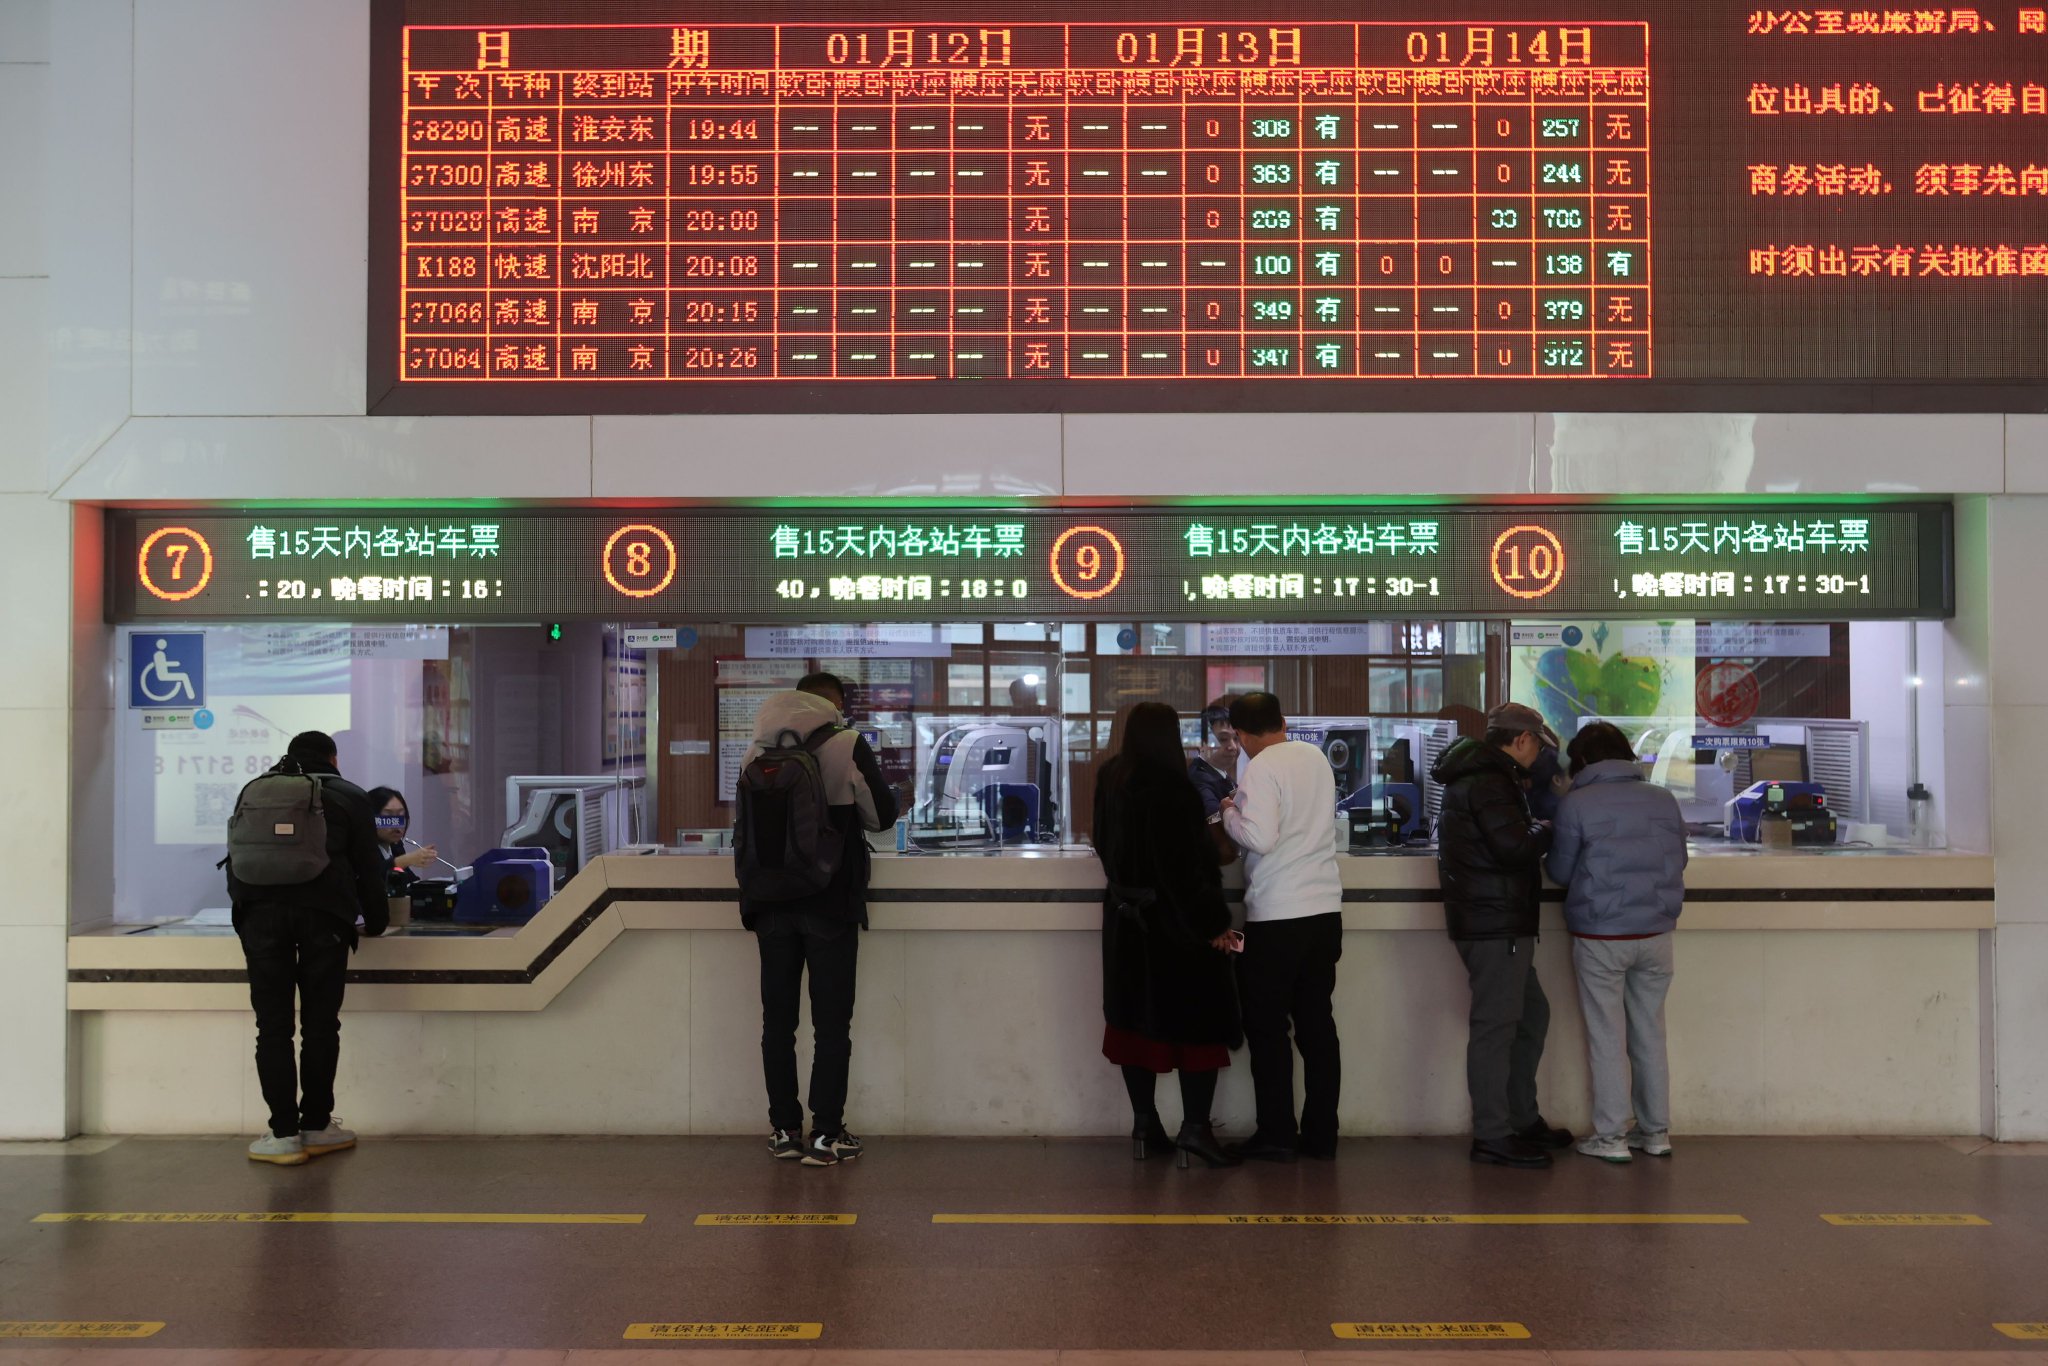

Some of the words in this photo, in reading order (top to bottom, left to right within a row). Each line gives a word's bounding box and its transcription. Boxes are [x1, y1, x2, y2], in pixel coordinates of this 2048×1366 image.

[477, 28, 511, 69] 日
[667, 27, 710, 69] 期
[826, 28, 1012, 69] 01月12日
[1116, 27, 1302, 68] 01月13日
[1406, 26, 1592, 68] 01月14日
[495, 115, 552, 143] 高速
[572, 115, 655, 142] 淮安东
[689, 119, 759, 140] 19:44
[1025, 115, 1051, 141] 无
[1253, 119, 1290, 137] 308
[1316, 115, 1341, 140] 有
[1543, 119, 1580, 137] 257
[1606, 114, 1631, 140] 无
[495, 160, 552, 188] 高速
[572, 161, 654, 188] 徐州东
[689, 165, 759, 186] 19:55
[1025, 161, 1051, 187] 无
[1253, 165, 1290, 183] 363
[1316, 161, 1341, 185] 有
[1543, 164, 1581, 183] 244
[1606, 160, 1632, 186] 无
[495, 206, 551, 234] 高速
[686, 210, 759, 232] 20:00
[1025, 207, 1051, 233] 无
[1315, 206, 1340, 230] 有
[1607, 205, 1632, 231] 无
[418, 256, 477, 278] K188
[495, 253, 550, 279] 快速
[571, 252, 654, 279] 沈阳北
[686, 256, 758, 277] 20:08
[1025, 252, 1051, 278] 无
[1254, 256, 1290, 274] 100
[1315, 251, 1340, 276] 有
[1546, 255, 1582, 274] 138
[1607, 251, 1632, 276] 有
[494, 298, 550, 325] 高速
[686, 302, 758, 322] 20:15
[1025, 297, 1051, 323] 无
[1253, 301, 1291, 320] 349
[1316, 297, 1341, 322] 有
[1545, 301, 1582, 320] 379
[1608, 296, 1632, 322] 无
[494, 344, 549, 371] 高速
[686, 348, 757, 369] 20:26
[1025, 343, 1051, 369] 无
[1253, 349, 1289, 366] 347
[1316, 343, 1341, 368] 有
[1545, 343, 1583, 366] 372
[1608, 341, 1633, 369] 无
[246, 525, 500, 559] 售15天内各站车票
[770, 524, 1024, 558] 售15天内各站车票
[1184, 522, 1438, 556] 售15天内各站车票
[1614, 520, 1869, 554] 售15天内各站车票
[165, 544, 190, 581] 7
[626, 543, 652, 577] 8
[1076, 546, 1101, 580] 9
[1504, 544, 1553, 580] 10
[1696, 737, 1766, 747] 一次购票限购10张
[649, 1324, 801, 1333] 请保持1米距离
[1353, 1324, 1506, 1333] 请保持1米距离
